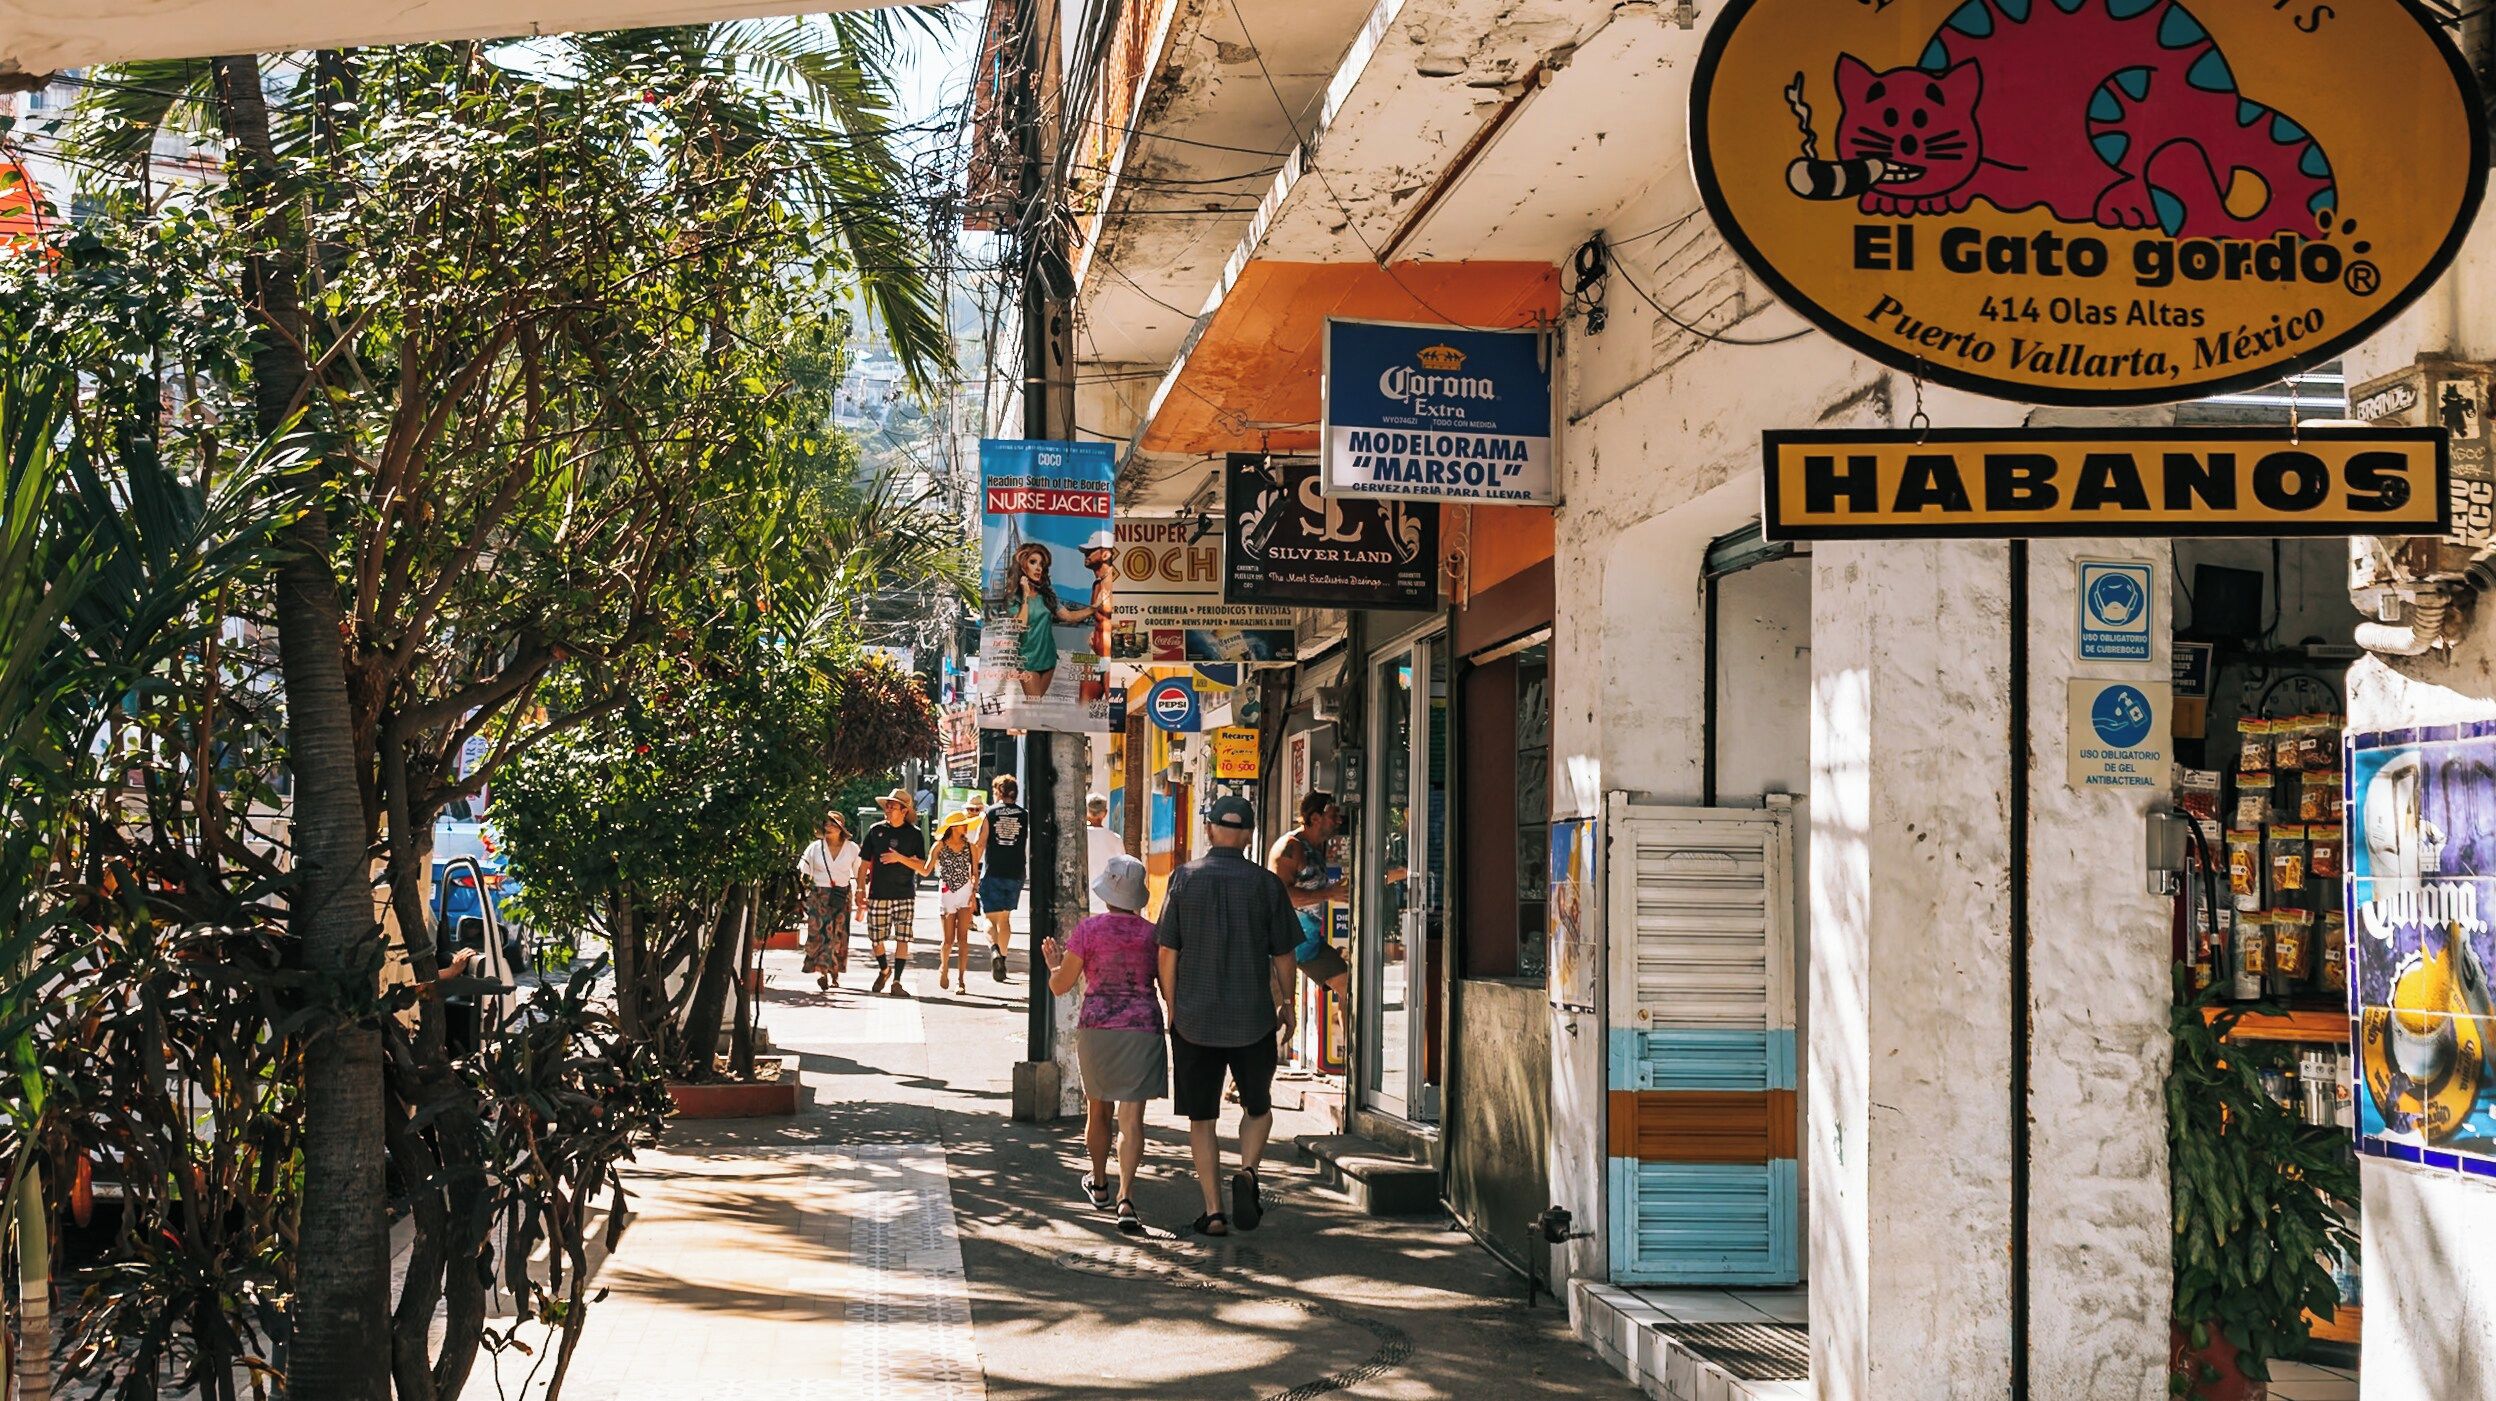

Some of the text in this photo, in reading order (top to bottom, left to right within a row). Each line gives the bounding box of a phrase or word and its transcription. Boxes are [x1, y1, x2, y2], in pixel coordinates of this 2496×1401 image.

[1854, 224, 1914, 271] El
[1940, 226, 2108, 277] Gato
[1979, 296, 2206, 328] 414 Olas Altas
[1864, 293, 2325, 381] Puerto Vallarta, México
[1379, 365, 1495, 404] Corona
[1415, 398, 1465, 418] Extra
[1432, 418, 1452, 427] TODO
[1453, 419, 1468, 428] CON
[1469, 420, 1497, 429] MEDIDA
[1349, 431, 1528, 461] MODELORAMA
[1038, 453, 1062, 467] COCO
[987, 475, 1110, 492] Heading South of the Border
[1804, 452, 2411, 513] HABANOS
[1414, 485, 1441, 495] FRIA
[1447, 488, 1480, 498] PARA
[1486, 490, 1532, 499] LLEVAR
[988, 492, 1109, 514] NURSE JACKIE
[1269, 547, 1393, 563] SILVER LAND
[1268, 571, 1284, 582] The
[1286, 573, 1307, 583] Most
[1147, 605, 1188, 615] CREMERIA
[1197, 605, 1246, 615] PERIODICOS
[1247, 605, 1253, 614] Y
[1255, 606, 1292, 615] REVISTAS
[1145, 618, 1175, 626] GROCERY
[1182, 618, 1200, 626] NEWS
[1202, 618, 1223, 626] PAPER
[1229, 618, 1267, 627] MAGAZINES
[1275, 619, 1292, 627] BEER
[2082, 633, 2148, 643] USO OBLIGATORIO
[2097, 645, 2145, 654] CUBREBOCAS
[1158, 701, 1187, 709] PEPSI
[1222, 732, 1255, 741] Recarga
[2080, 750, 2160, 760] USO OBLIGATORIO
[2104, 763, 2136, 773] DE GEL
[2085, 775, 2155, 786] ANTIBACTERIAL
